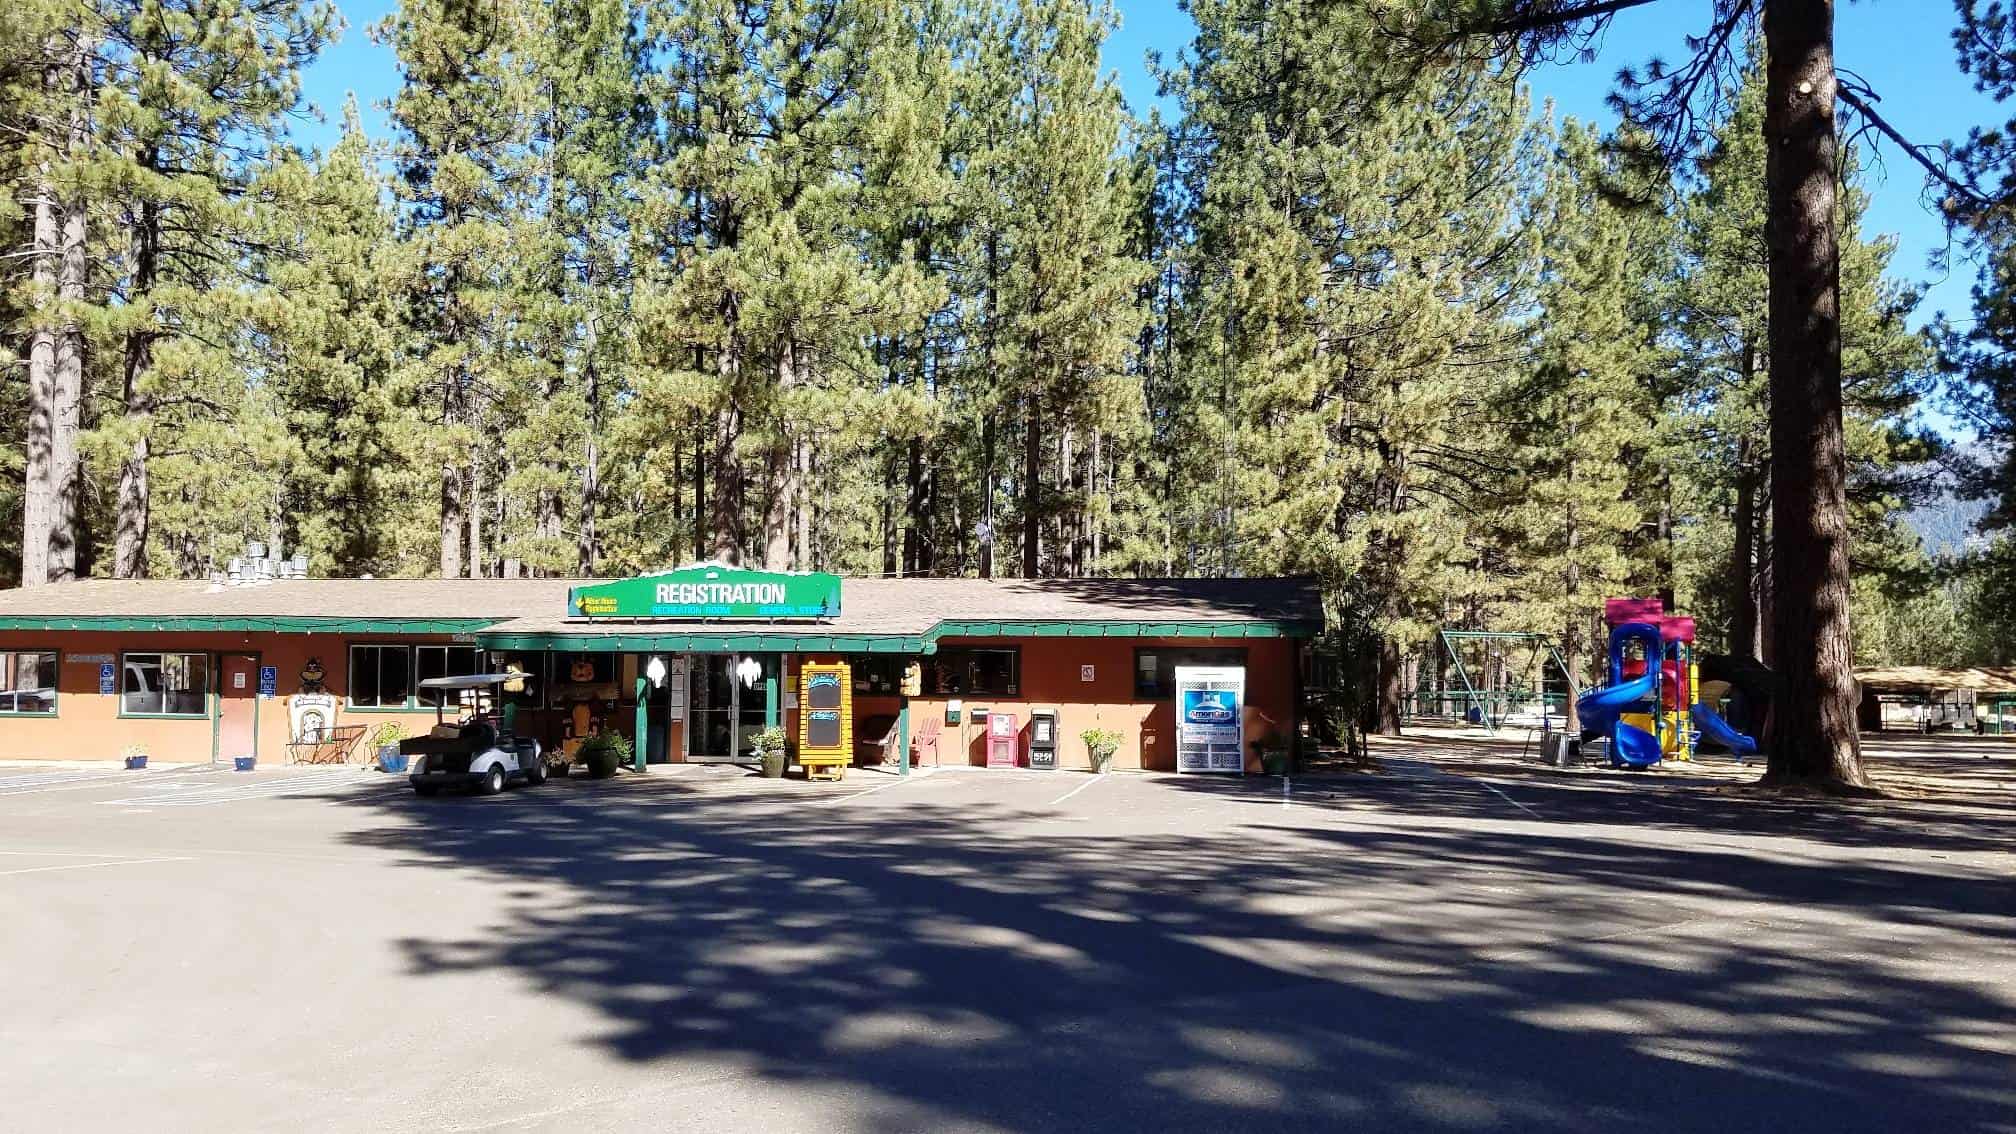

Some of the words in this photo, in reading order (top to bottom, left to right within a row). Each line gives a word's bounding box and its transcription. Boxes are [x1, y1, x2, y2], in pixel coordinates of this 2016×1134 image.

[656, 583, 786, 604] REGISTRATION
[652, 606, 702, 615] RECREATION
[705, 606, 731, 615] ROOM
